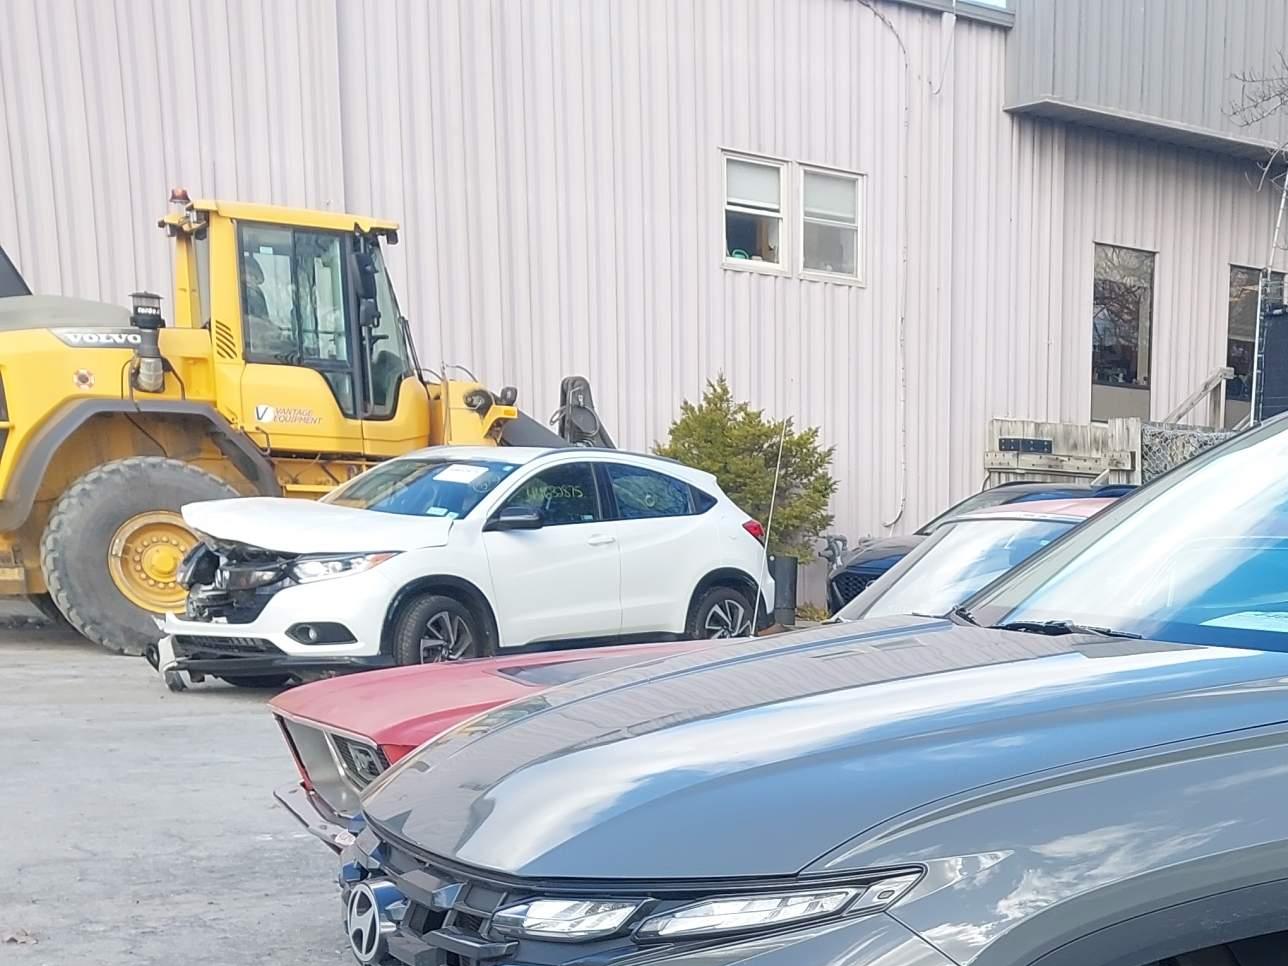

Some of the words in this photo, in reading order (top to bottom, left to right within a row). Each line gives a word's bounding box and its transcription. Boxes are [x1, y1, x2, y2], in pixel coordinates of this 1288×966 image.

[66, 333, 142, 344] VOLVO
[275, 407, 313, 416] VANTAGE
[273, 415, 322, 425] EQUIPMENT
